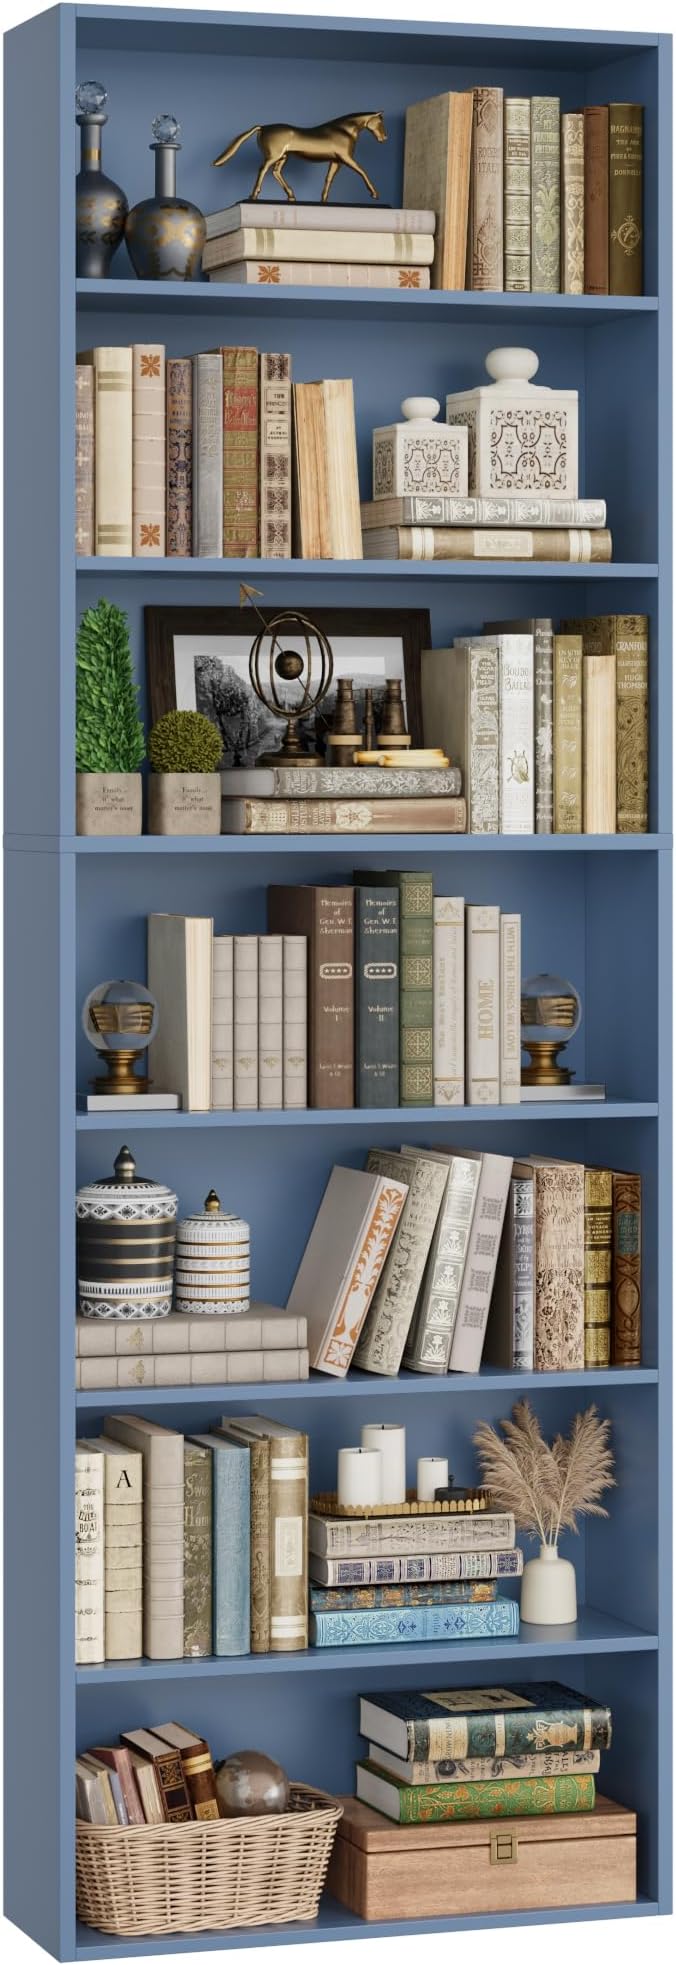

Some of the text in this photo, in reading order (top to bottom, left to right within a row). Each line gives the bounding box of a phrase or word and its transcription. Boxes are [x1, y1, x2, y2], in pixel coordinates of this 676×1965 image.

[321, 899, 352, 907] Memoirs
[365, 899, 397, 907] Memoirs
[333, 907, 341, 916] of
[378, 908, 385, 916] of
[320, 926, 352, 934] Sherman
[363, 926, 397, 934] Sherman
[506, 927, 516, 1053] WITH THE THINGS WE LOVE
[323, 1005, 351, 1013] Volume
[367, 1005, 394, 1013] Volume
[478, 980, 494, 1039] HOME
[115, 1469, 132, 1488] A
[79, 1522, 97, 1532] BOAT
